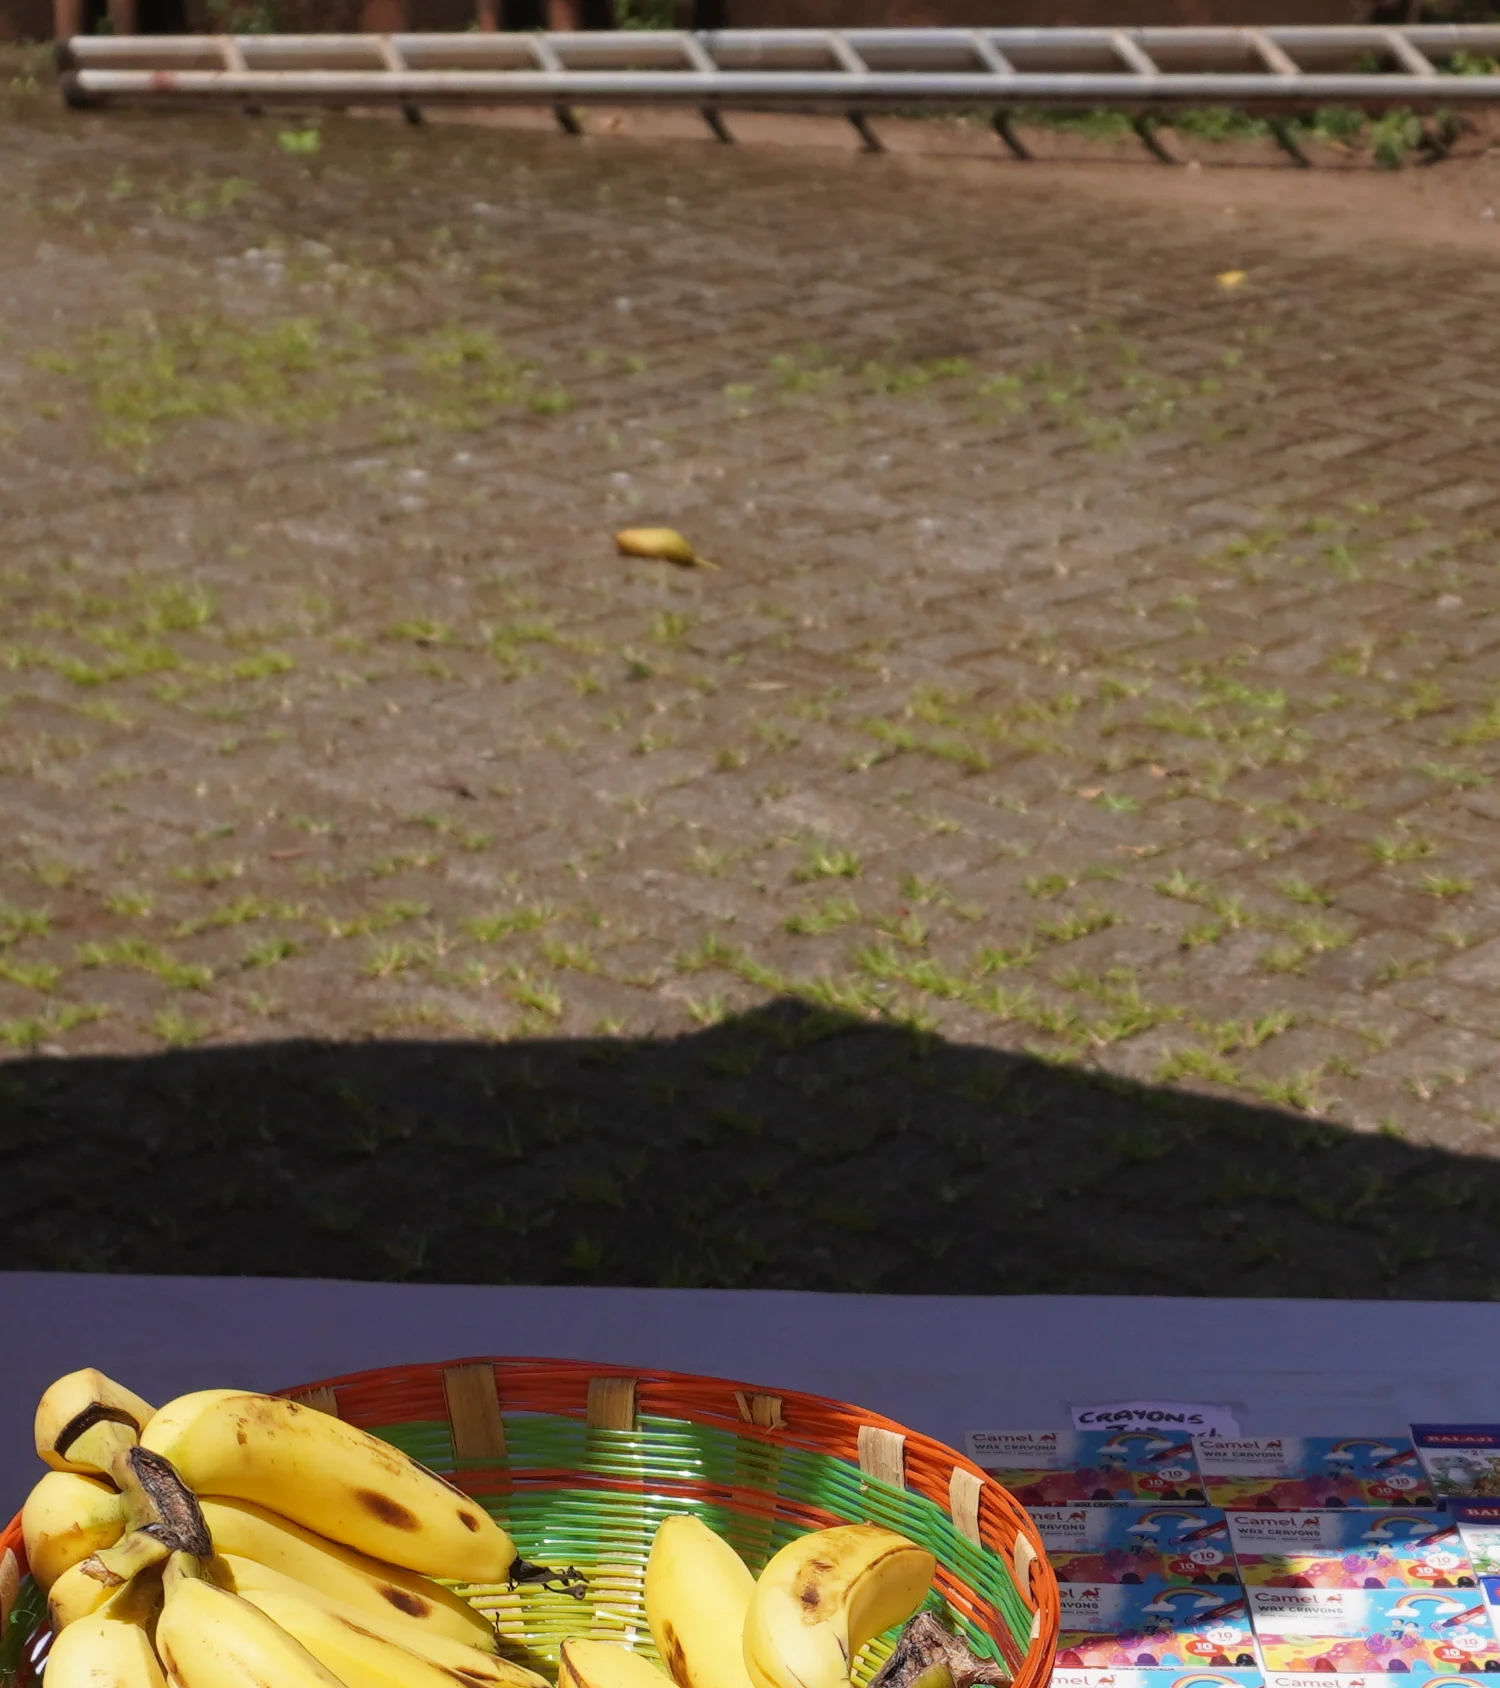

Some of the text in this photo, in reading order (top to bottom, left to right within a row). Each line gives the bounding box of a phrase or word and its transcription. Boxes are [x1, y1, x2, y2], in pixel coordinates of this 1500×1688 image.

[1079, 1410, 1203, 1423] CRAYONS
[1201, 1440, 1260, 1449] Camel
[1234, 1517, 1296, 1527] Camel
[1268, 1528, 1320, 1536] CRAYONS
[1255, 1593, 1317, 1603] Camel
[1258, 1605, 1343, 1614] WAX CRAYONS
[1276, 1678, 1340, 1688] Camel
